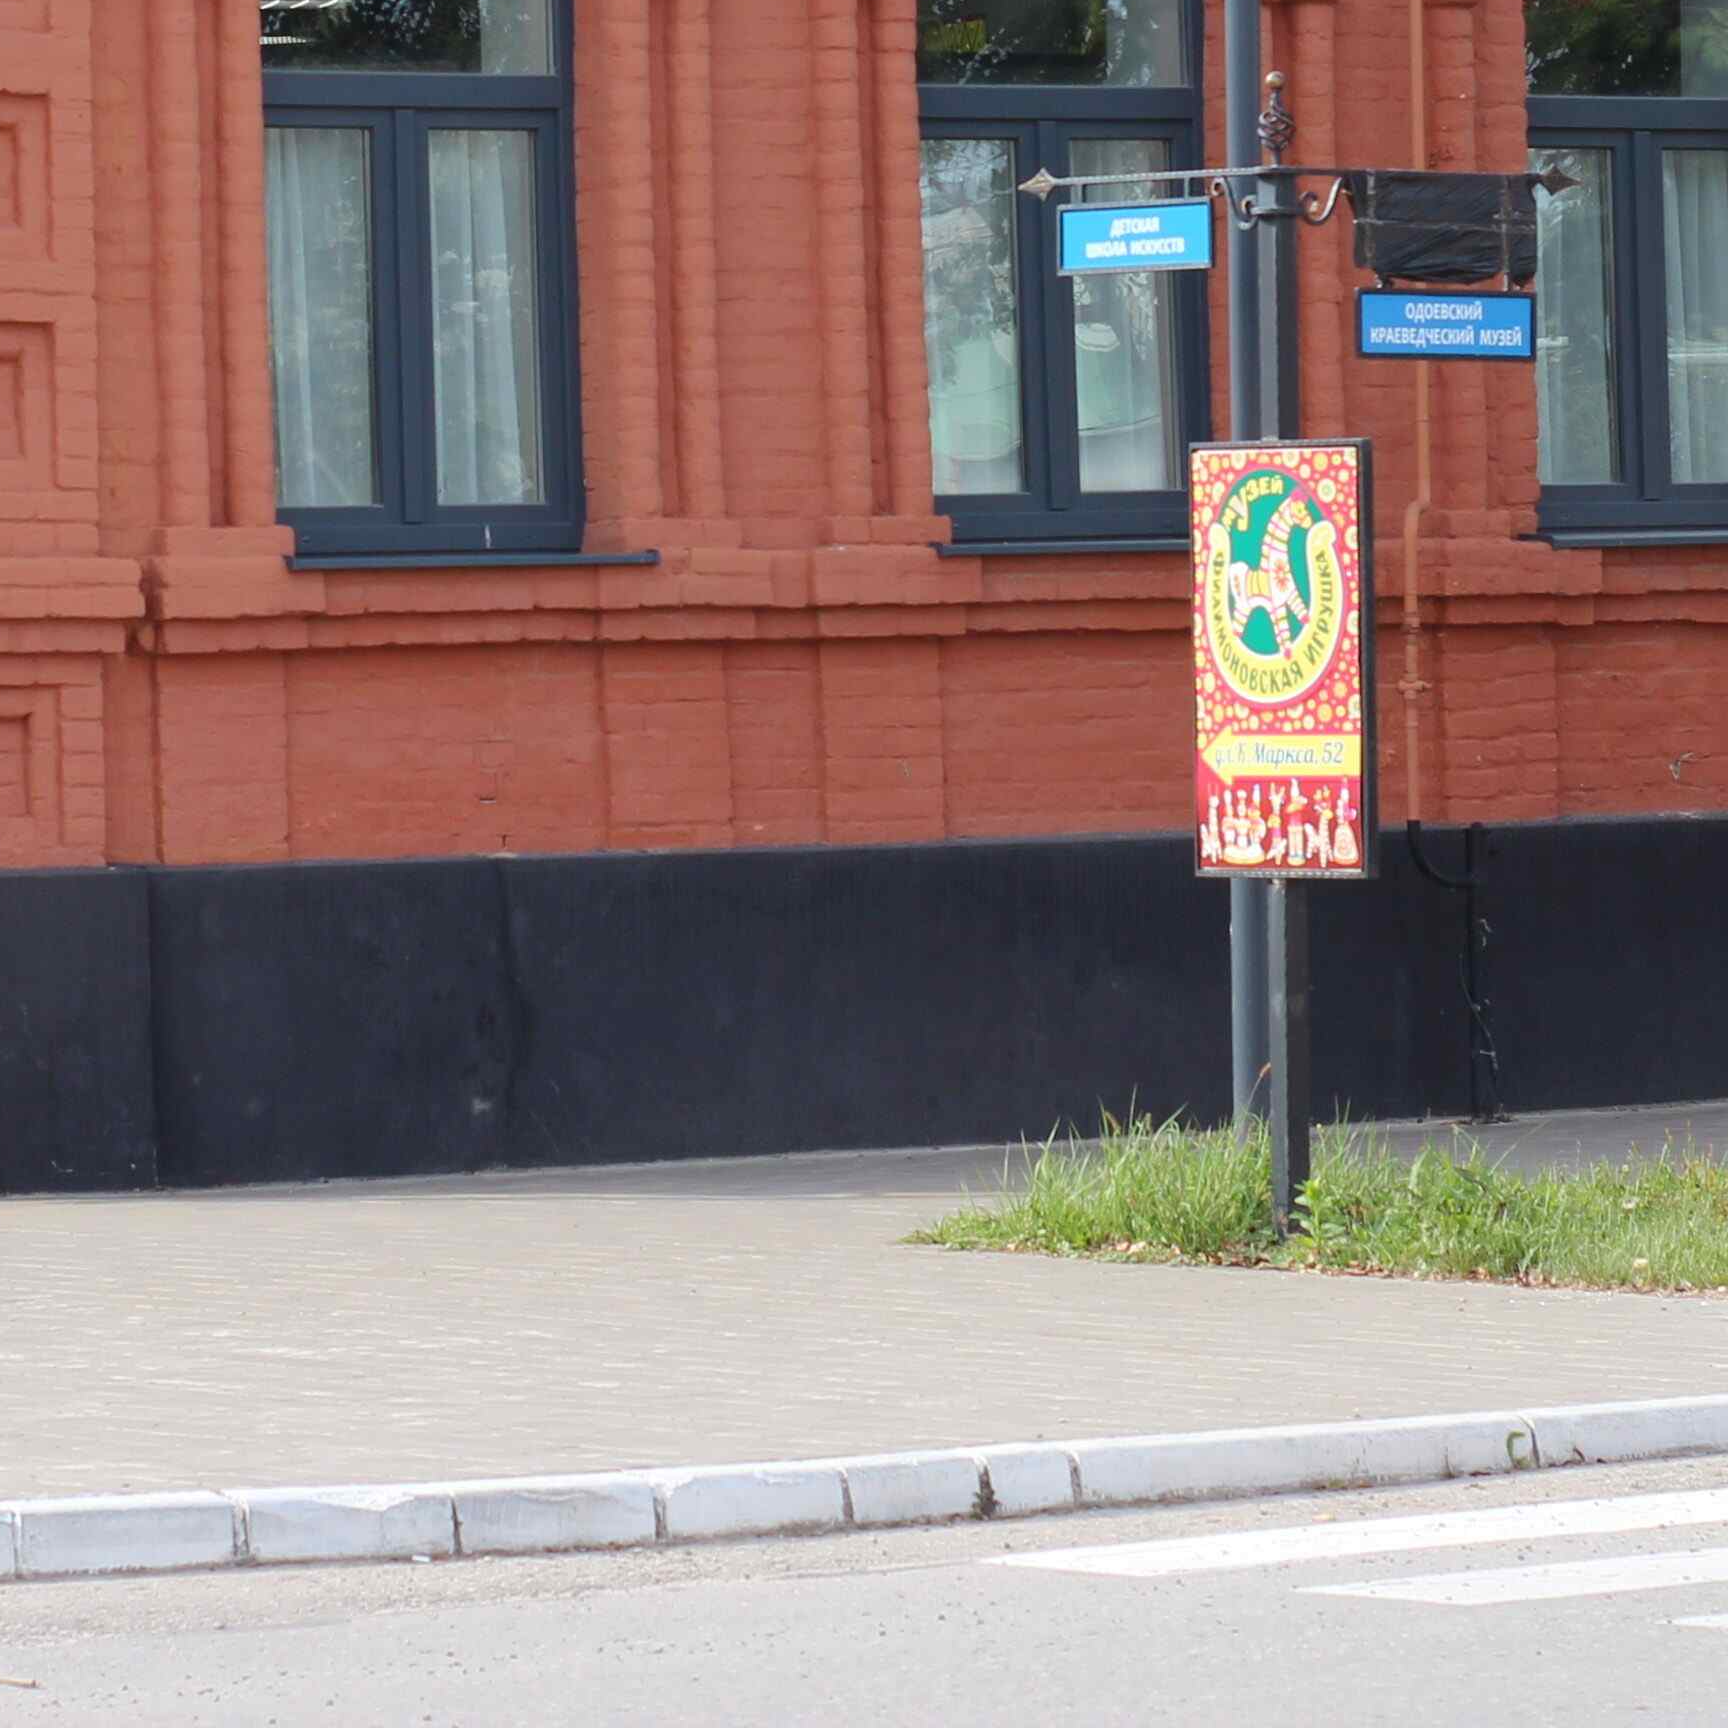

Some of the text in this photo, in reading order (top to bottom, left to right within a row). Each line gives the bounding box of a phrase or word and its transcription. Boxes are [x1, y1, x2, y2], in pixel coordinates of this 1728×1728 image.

[1405, 301, 1483, 323] ОДОЕВСКИЙ
[1370, 326, 1522, 348] КРАЕВЕДЧЕСКИЙ МУЗЕЙ
[1222, 476, 1284, 532] МУЗЕЙ
[1212, 549, 1334, 694] ФИЛИМОНОВСКАЯ ИГРУШКА
[1322, 741, 1344, 765] 52
